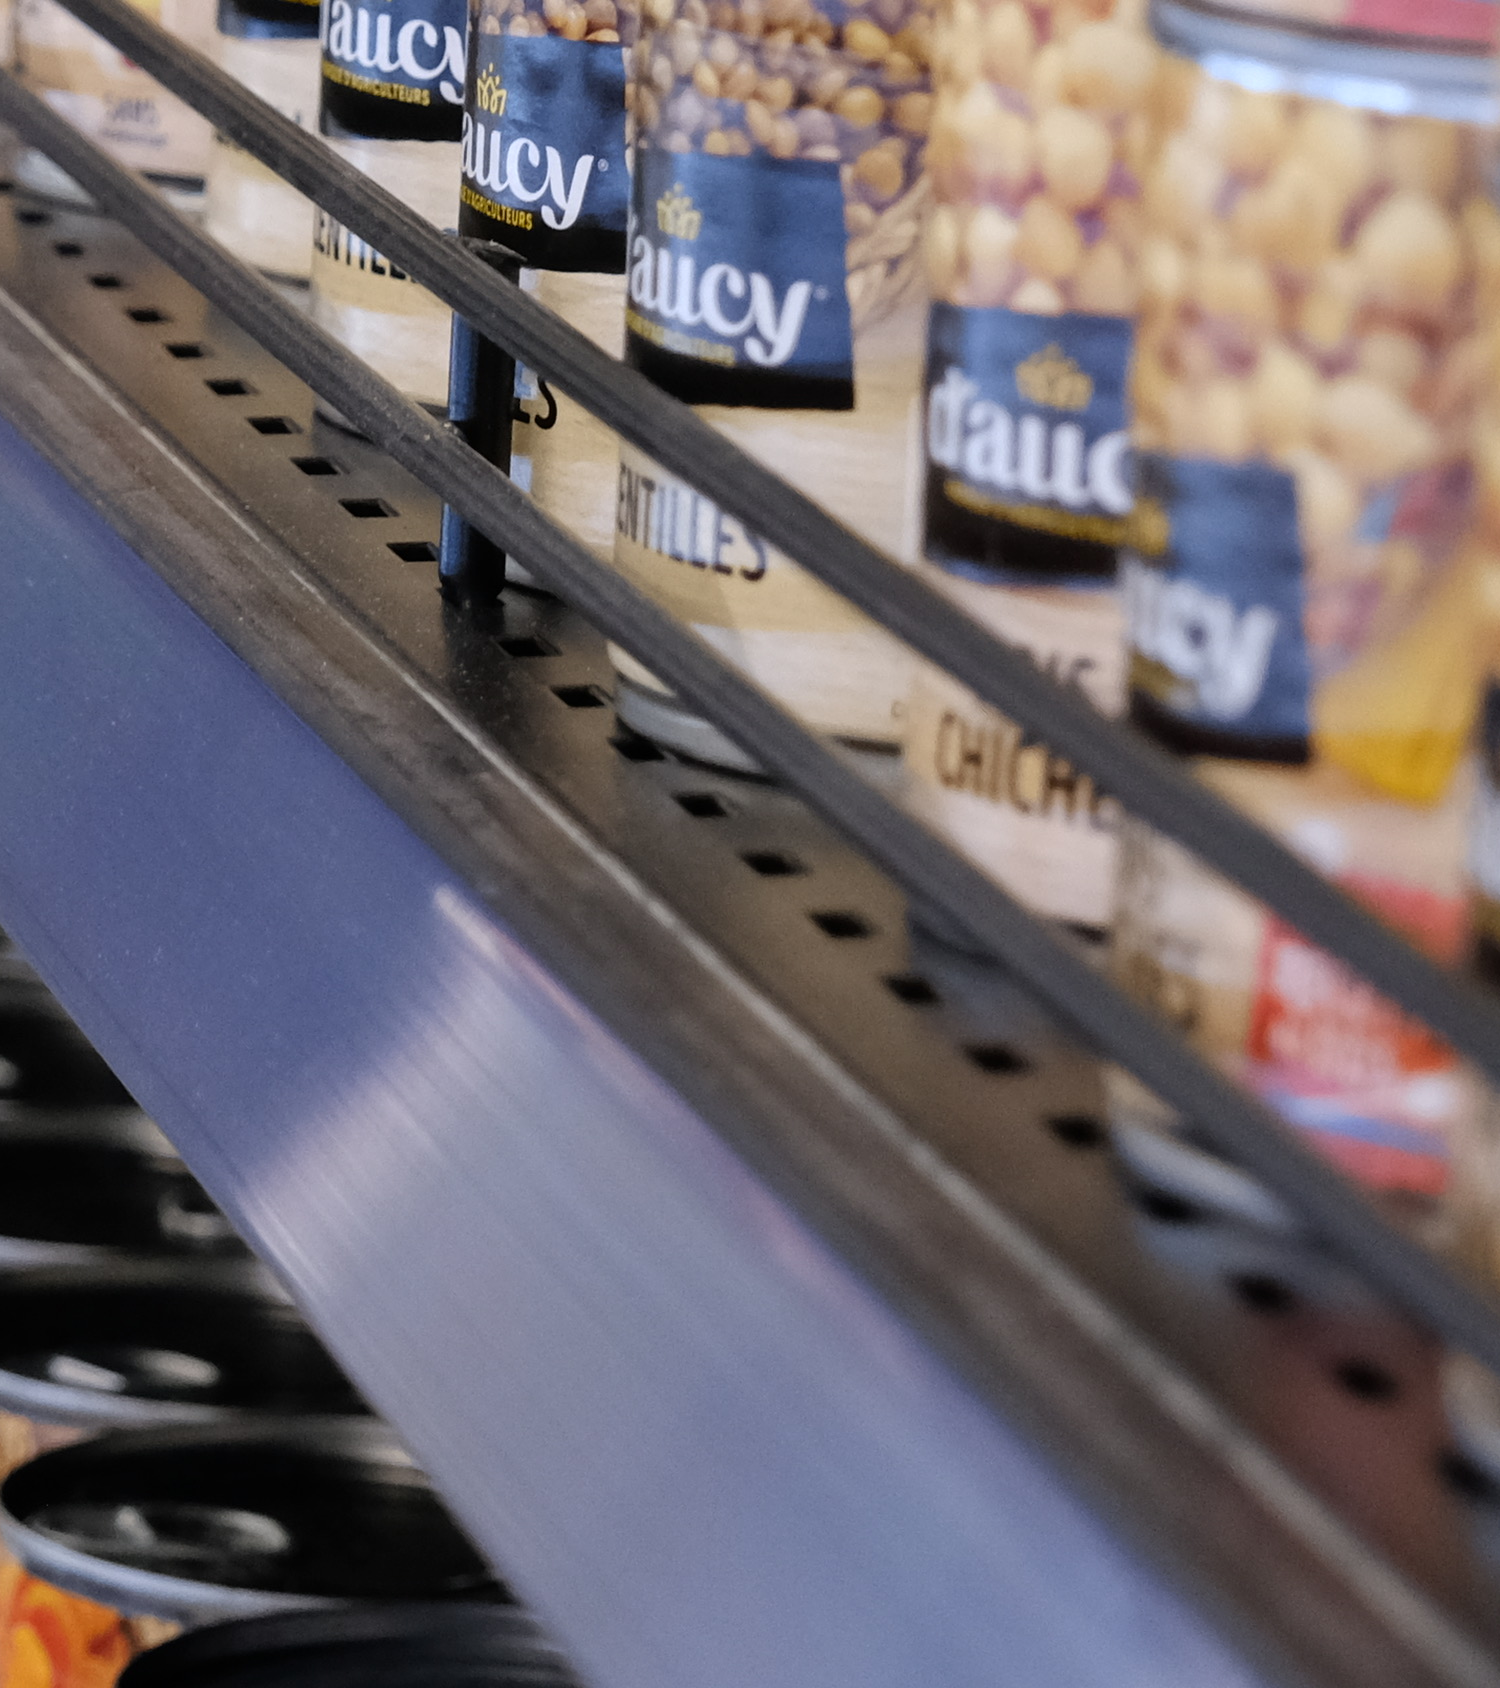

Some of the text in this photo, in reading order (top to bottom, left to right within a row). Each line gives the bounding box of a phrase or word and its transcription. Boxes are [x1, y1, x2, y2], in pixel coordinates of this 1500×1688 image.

[461, 111, 594, 230] aucy
[629, 215, 812, 366] aucy
[616, 461, 768, 581] ENTILLES
